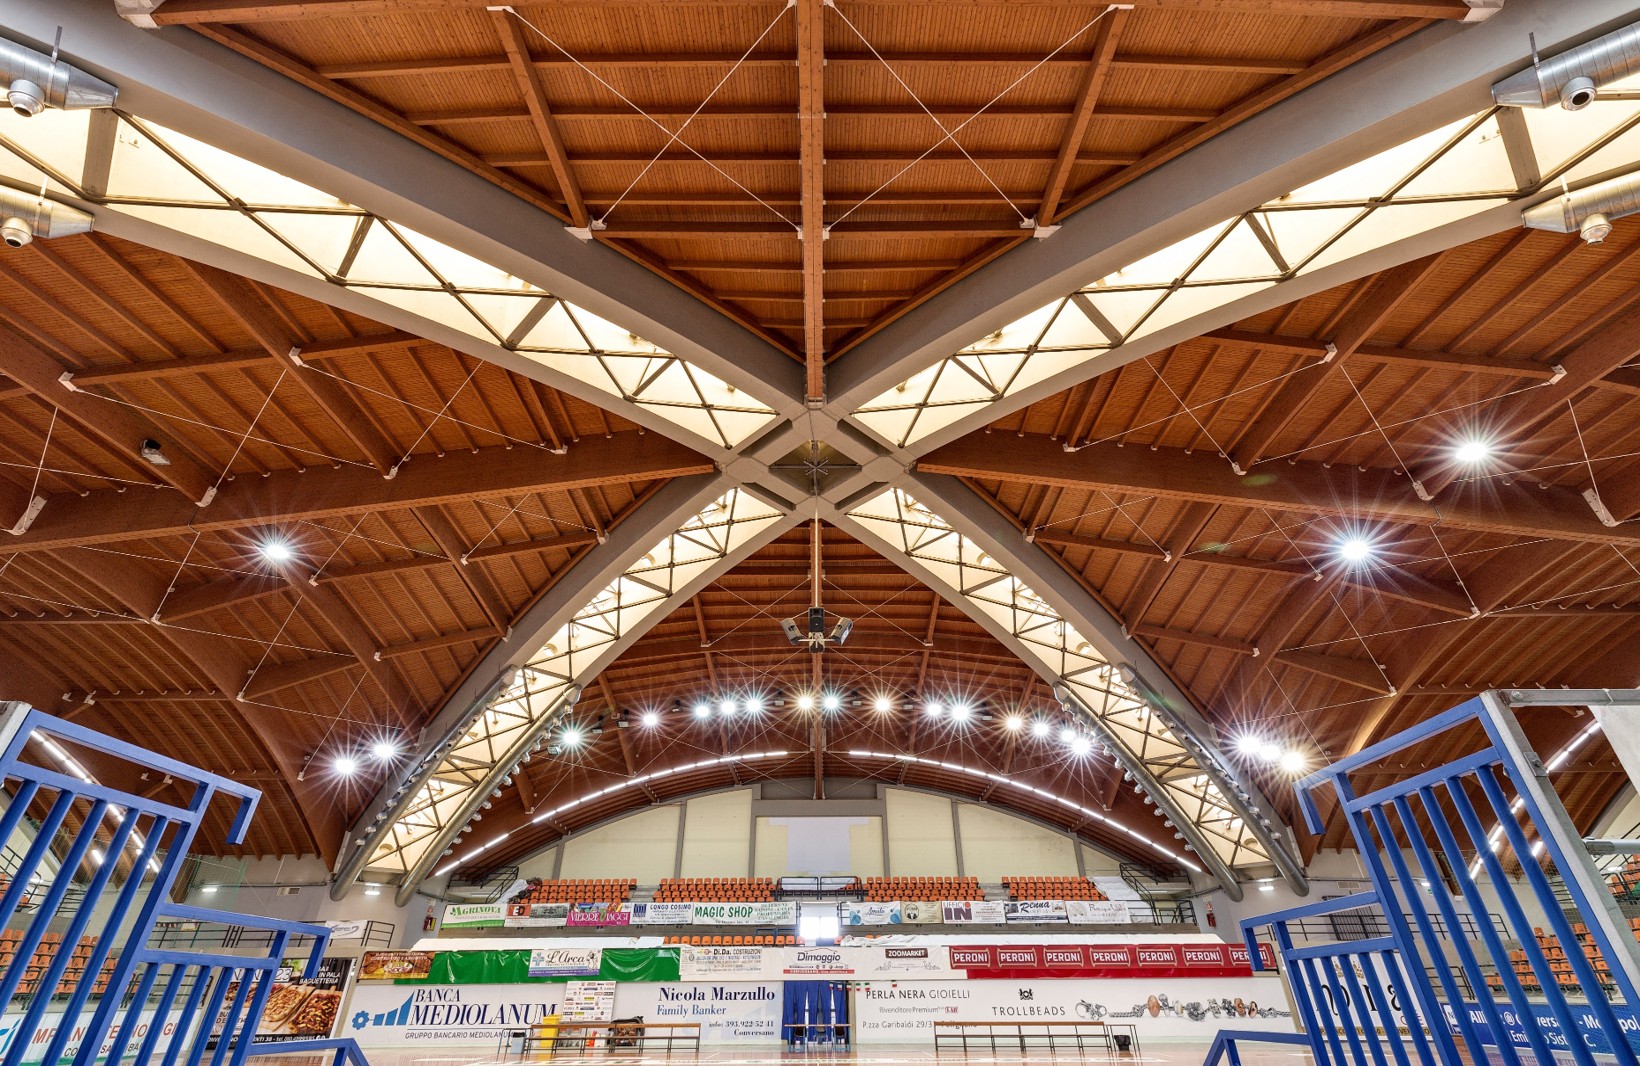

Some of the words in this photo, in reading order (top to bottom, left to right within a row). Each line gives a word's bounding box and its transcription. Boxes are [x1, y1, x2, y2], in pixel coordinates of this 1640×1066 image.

[694, 906, 725, 918] MAGIC
[727, 906, 754, 918] SHOP
[944, 907, 973, 920] IN
[797, 952, 841, 963] Dimaggio
[953, 952, 988, 963] PERONI
[1000, 952, 1035, 963] PERONI
[1046, 952, 1081, 962] PERONI
[1093, 952, 1128, 962] PERONI
[1139, 951, 1174, 962] PERONI
[1186, 951, 1221, 961] PERONI
[415, 988, 460, 1003] BANCA
[658, 986, 706, 1001] Nicola
[711, 986, 776, 1001] Marzullo
[866, 990, 896, 999] PERLA
[898, 989, 926, 999] NERA
[928, 989, 970, 999] GIOIELLI
[408, 1003, 558, 1026] MEDIOLANUM
[656, 1004, 689, 1018] Family
[692, 1004, 727, 1015] Banker
[992, 1006, 1066, 1016] TROLLBEADS
[434, 1031, 468, 1039] BANCARIO
